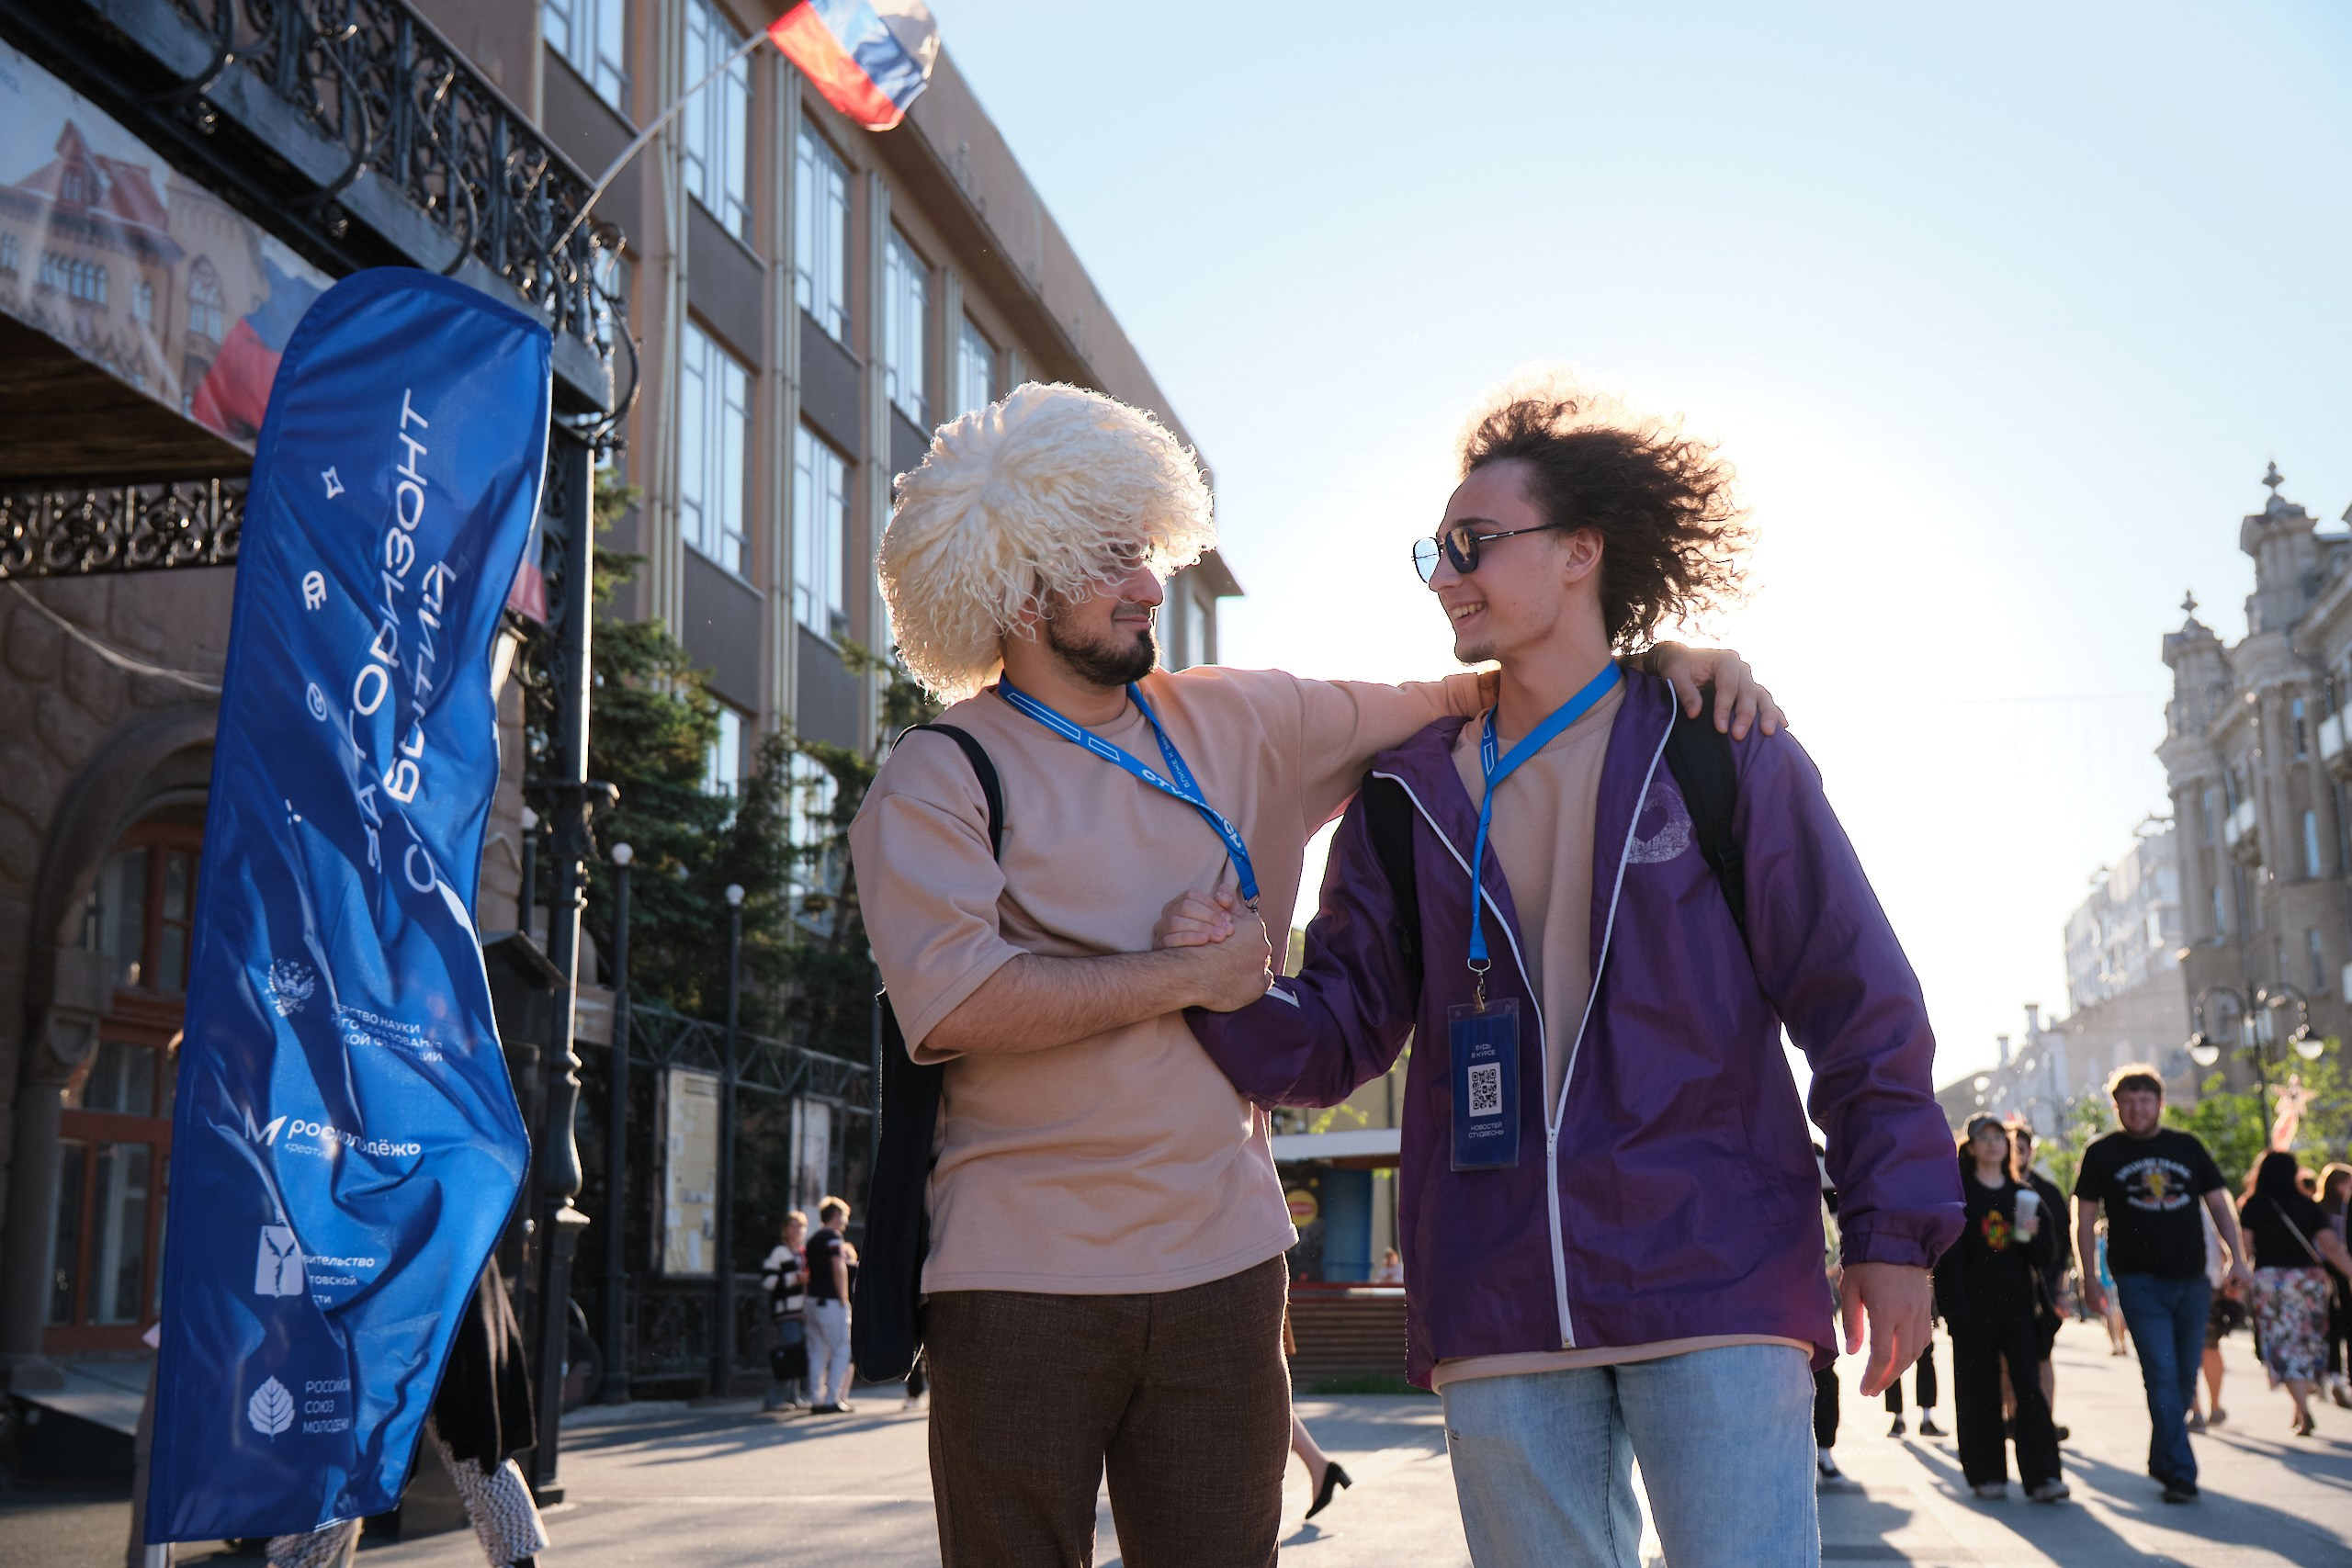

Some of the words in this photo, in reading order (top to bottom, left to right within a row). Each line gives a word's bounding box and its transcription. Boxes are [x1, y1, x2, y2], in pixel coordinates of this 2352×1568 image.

[349, 388, 429, 762] ГОРИЗОНТ
[383, 560, 458, 894] СБЫТИЙ
[379, 1017, 421, 1034] НАУКИ
[1476, 1049, 1496, 1057] КУРСЕ
[1470, 1122, 1502, 1131] НОВОСТЕЙ
[303, 1400, 335, 1415] СОЮЗ
